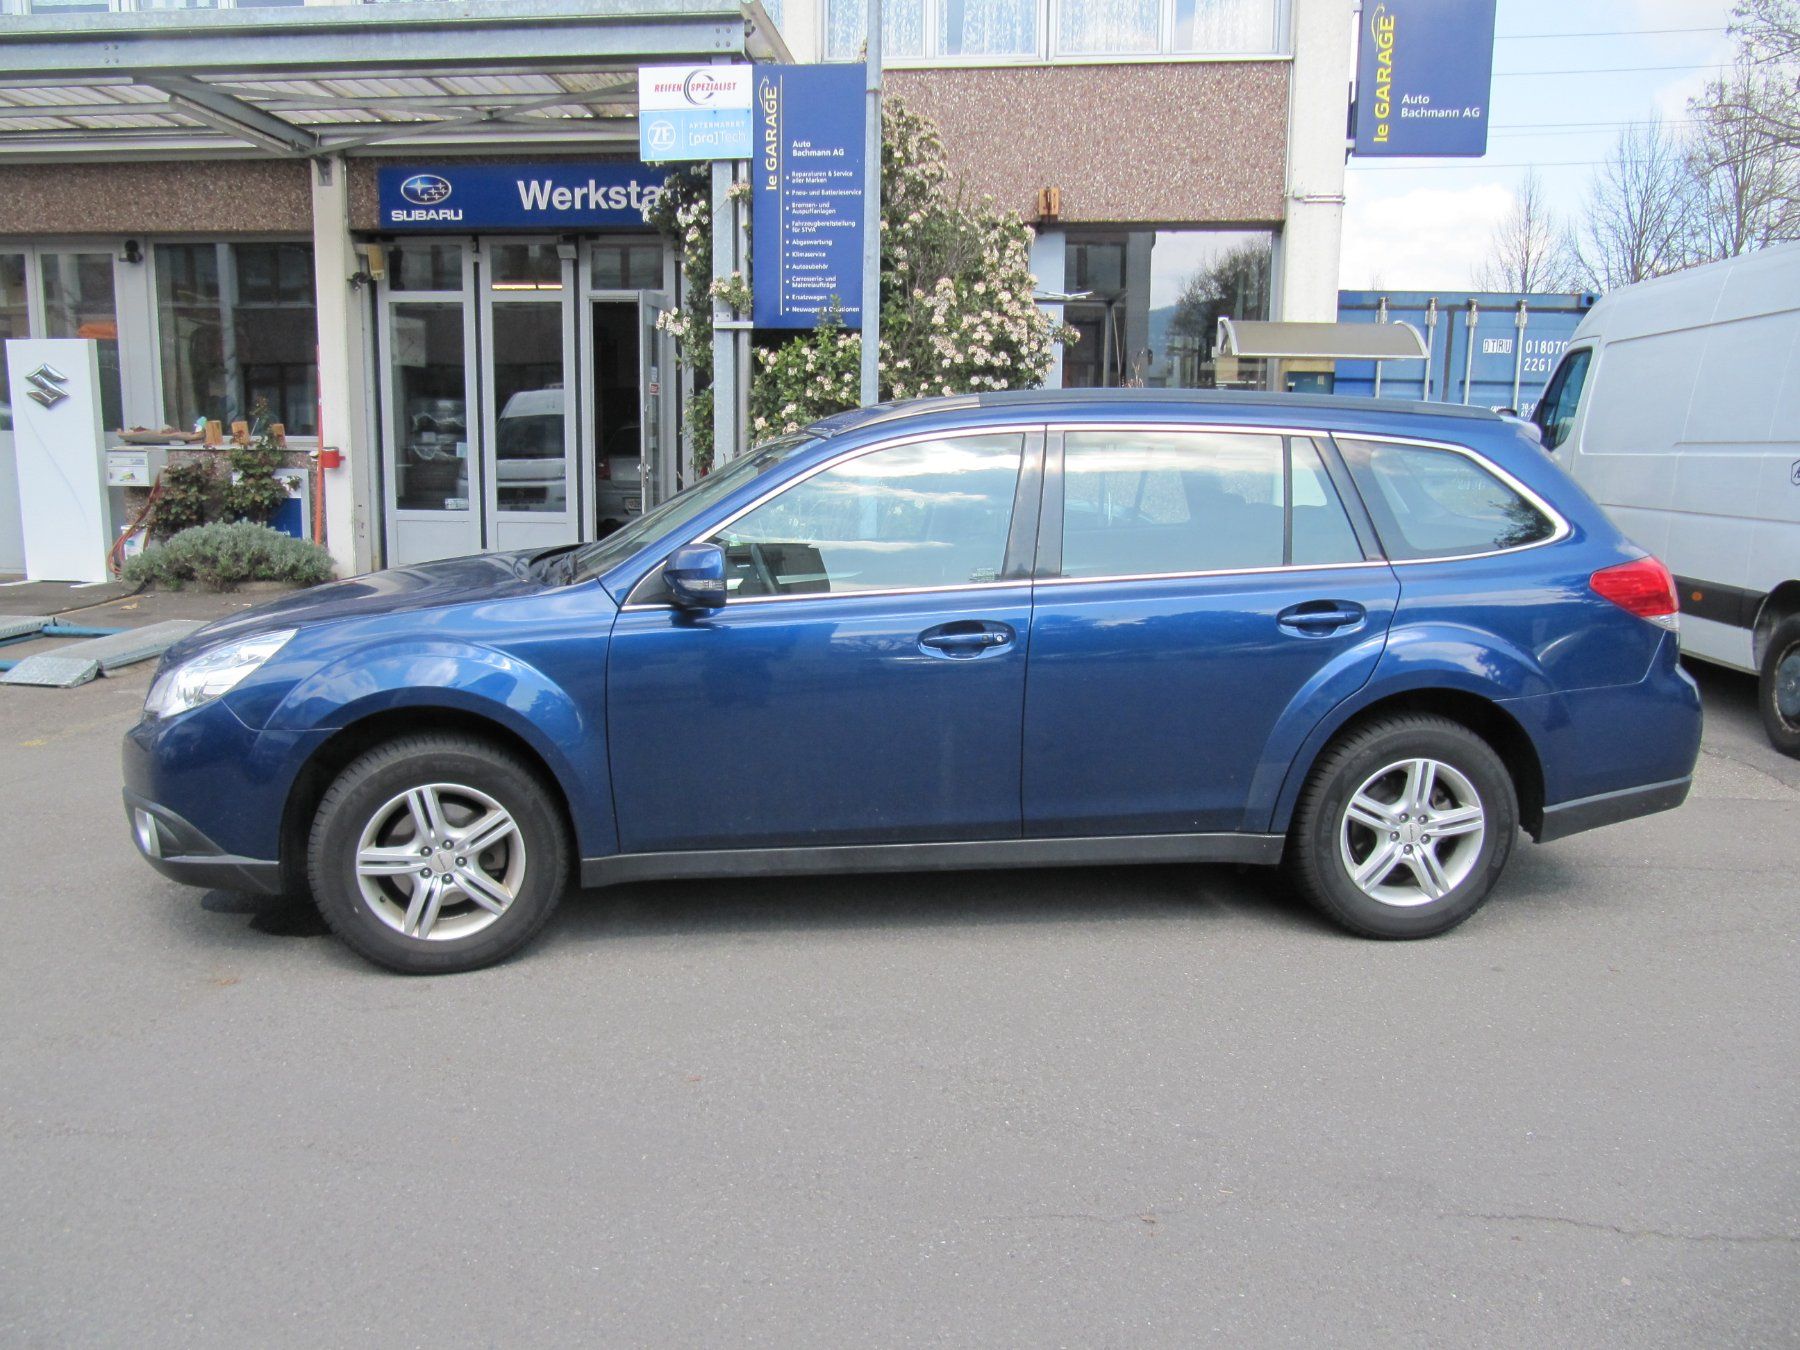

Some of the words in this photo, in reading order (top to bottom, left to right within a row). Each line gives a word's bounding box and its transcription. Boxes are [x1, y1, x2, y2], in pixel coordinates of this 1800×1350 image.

[1374, 14, 1395, 119] GARAGE
[654, 83, 683, 93] REIFEN
[690, 82, 737, 92] SPEZIALIST
[1401, 94, 1430, 104] Auto
[1401, 107, 1459, 118] Bachmann
[1463, 107, 1480, 118] AG
[765, 86, 777, 171] GARAGE
[1373, 123, 1389, 142] le
[792, 140, 811, 148] Auto
[792, 148, 831, 157] Bachmann
[833, 148, 844, 156] AG
[766, 175, 777, 190] le
[391, 209, 463, 221] SUBARU
[1524, 357, 1552, 371] 22G1
